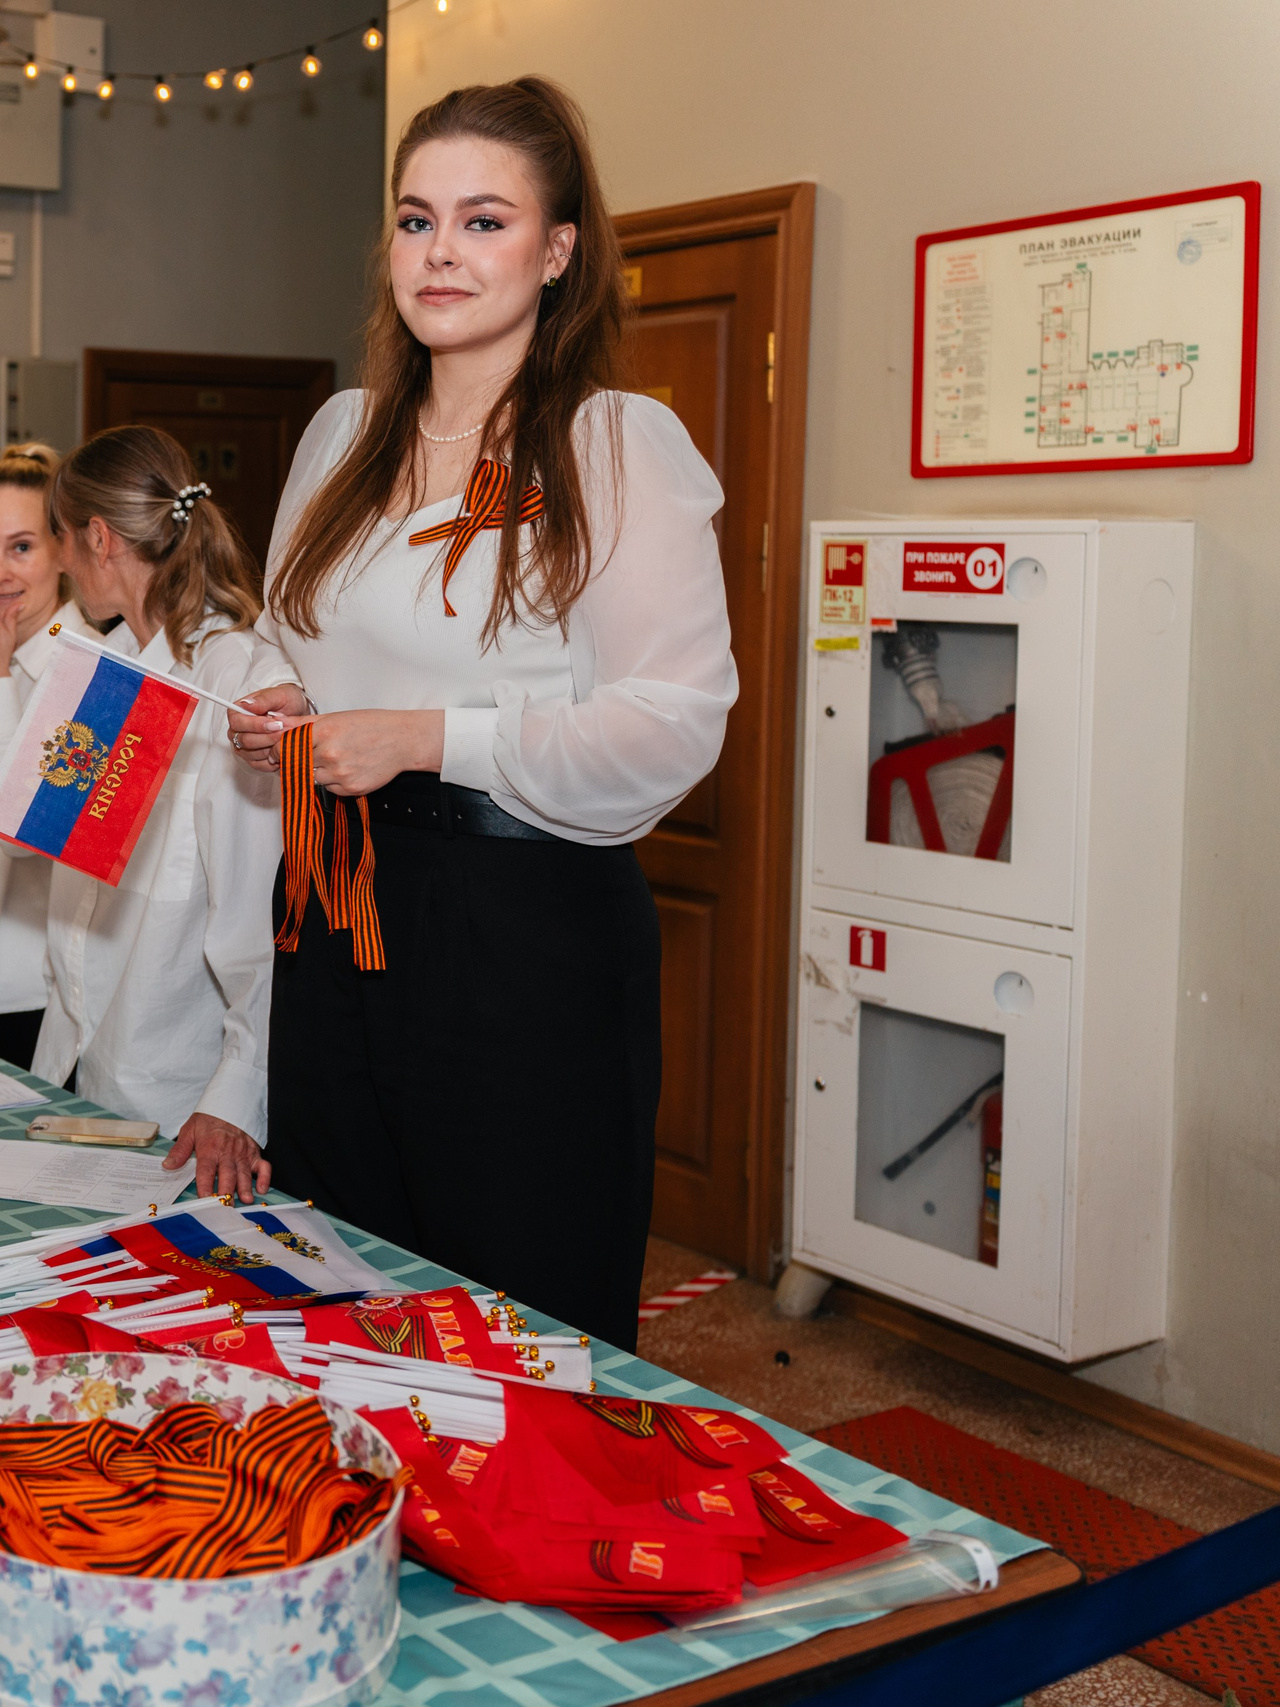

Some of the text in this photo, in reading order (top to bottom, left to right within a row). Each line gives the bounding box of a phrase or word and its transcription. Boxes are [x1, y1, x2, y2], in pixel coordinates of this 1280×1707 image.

[1019, 228, 1142, 255] ПЛАН ЭВАКУАЦИИ
[906, 552, 966, 565] ПРИ ПОЖАРЕ
[973, 560, 997, 577] 01
[913, 570, 957, 584] ЗВОНИТЬ
